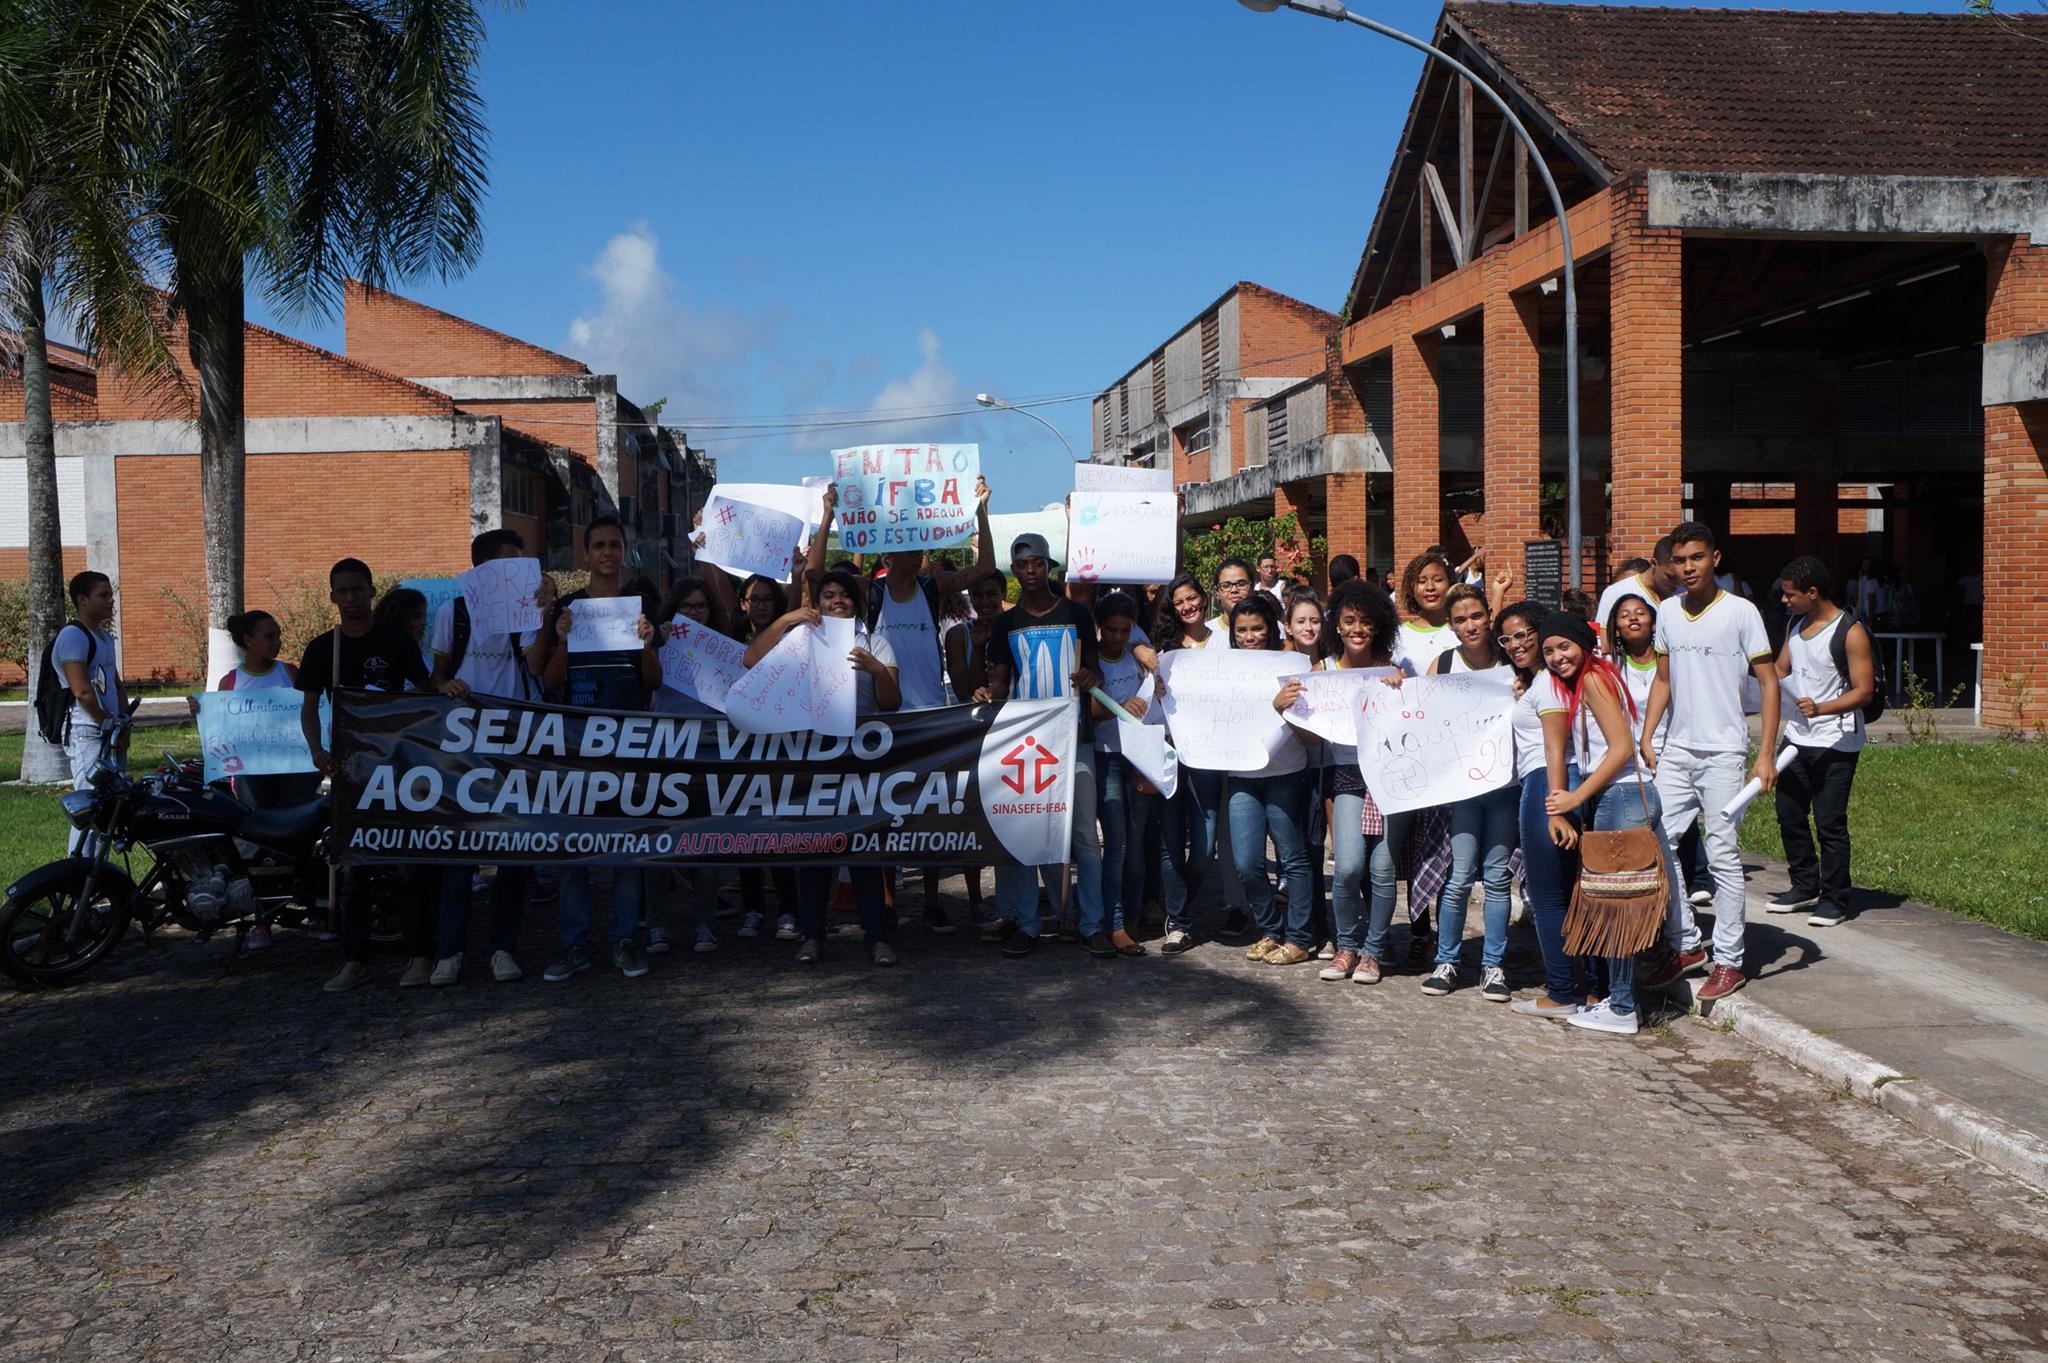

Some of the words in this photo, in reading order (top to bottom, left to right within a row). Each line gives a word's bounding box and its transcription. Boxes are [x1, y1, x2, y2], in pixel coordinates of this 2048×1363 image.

[837, 444, 969, 478] ENTÃO
[842, 507, 877, 526] NÃO
[889, 508, 910, 525] SE
[917, 507, 964, 521] ADEQUA
[846, 528, 878, 548] AOS
[440, 707, 566, 757] SEJA
[579, 716, 702, 760] BEM
[716, 720, 894, 761] VINDO
[357, 765, 443, 812] AO
[456, 767, 692, 817] CAMPUS
[705, 770, 971, 828] VALENÇA!
[350, 827, 405, 850] AQUI
[408, 825, 454, 851] NÓS
[458, 831, 560, 853] LUTAMOS
[564, 832, 651, 854] CONTRA
[656, 833, 672, 854] O
[675, 832, 848, 855] AUTORITARISMO
[851, 832, 881, 852] DA
[888, 831, 984, 853] REITORIA.
